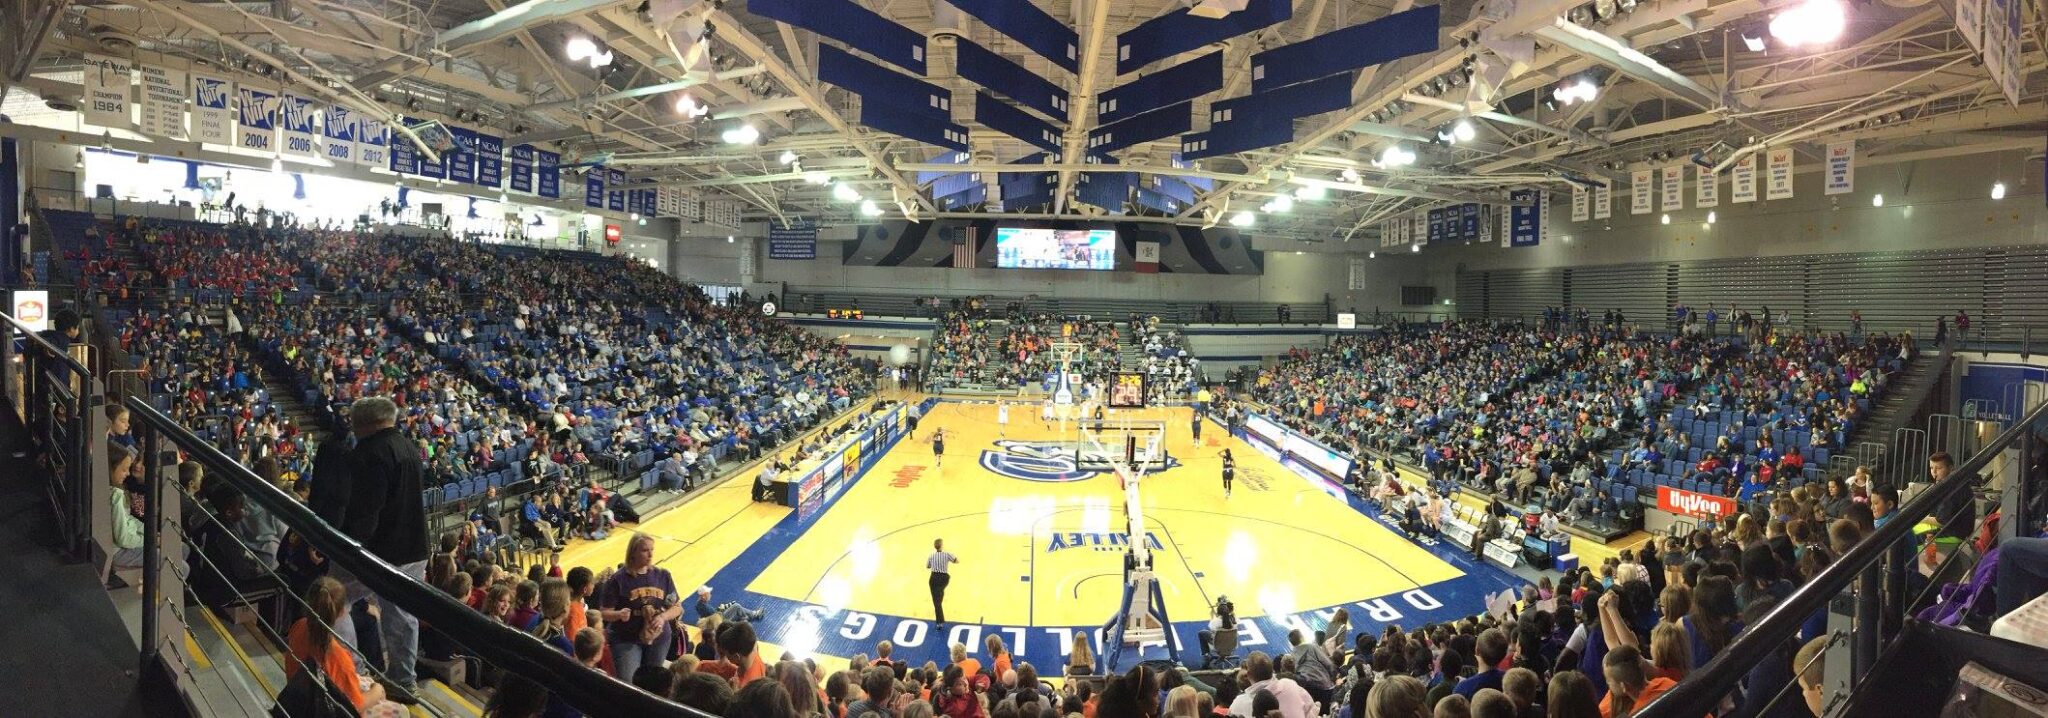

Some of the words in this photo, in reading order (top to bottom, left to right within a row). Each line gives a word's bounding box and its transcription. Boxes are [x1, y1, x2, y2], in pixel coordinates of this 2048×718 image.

[144, 76, 172, 86] NATIONAL
[93, 91, 123, 101] CHAMPION
[148, 93, 184, 105] TOURNAMENT
[93, 100, 123, 113] 1984
[201, 120, 221, 129] FINAL
[244, 132, 269, 149] 2004
[289, 136, 312, 152] 2006
[481, 141, 500, 152] NCAA
[328, 143, 350, 159] 2008
[363, 149, 383, 163] 2012
[514, 149, 531, 160] NCAA
[1670, 490, 1721, 515] HyVee
